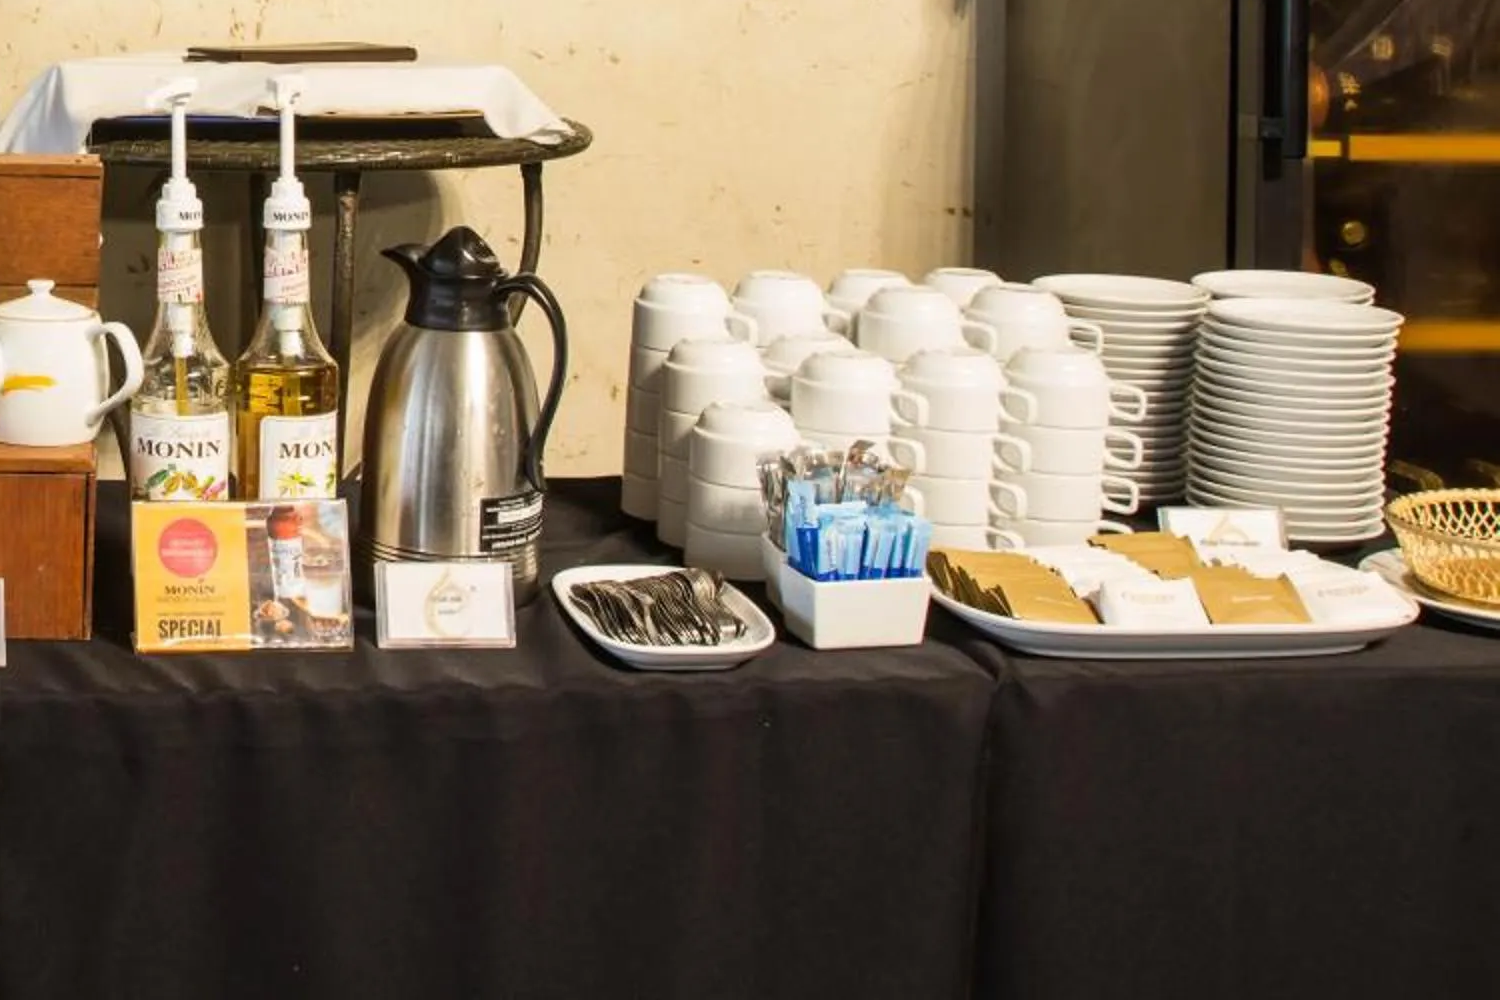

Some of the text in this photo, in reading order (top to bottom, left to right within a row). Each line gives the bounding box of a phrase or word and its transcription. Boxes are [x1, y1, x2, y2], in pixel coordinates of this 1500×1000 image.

[137, 437, 221, 458] MONIN
[164, 585, 215, 595] MONIN
[157, 619, 222, 639] SPECIAL
